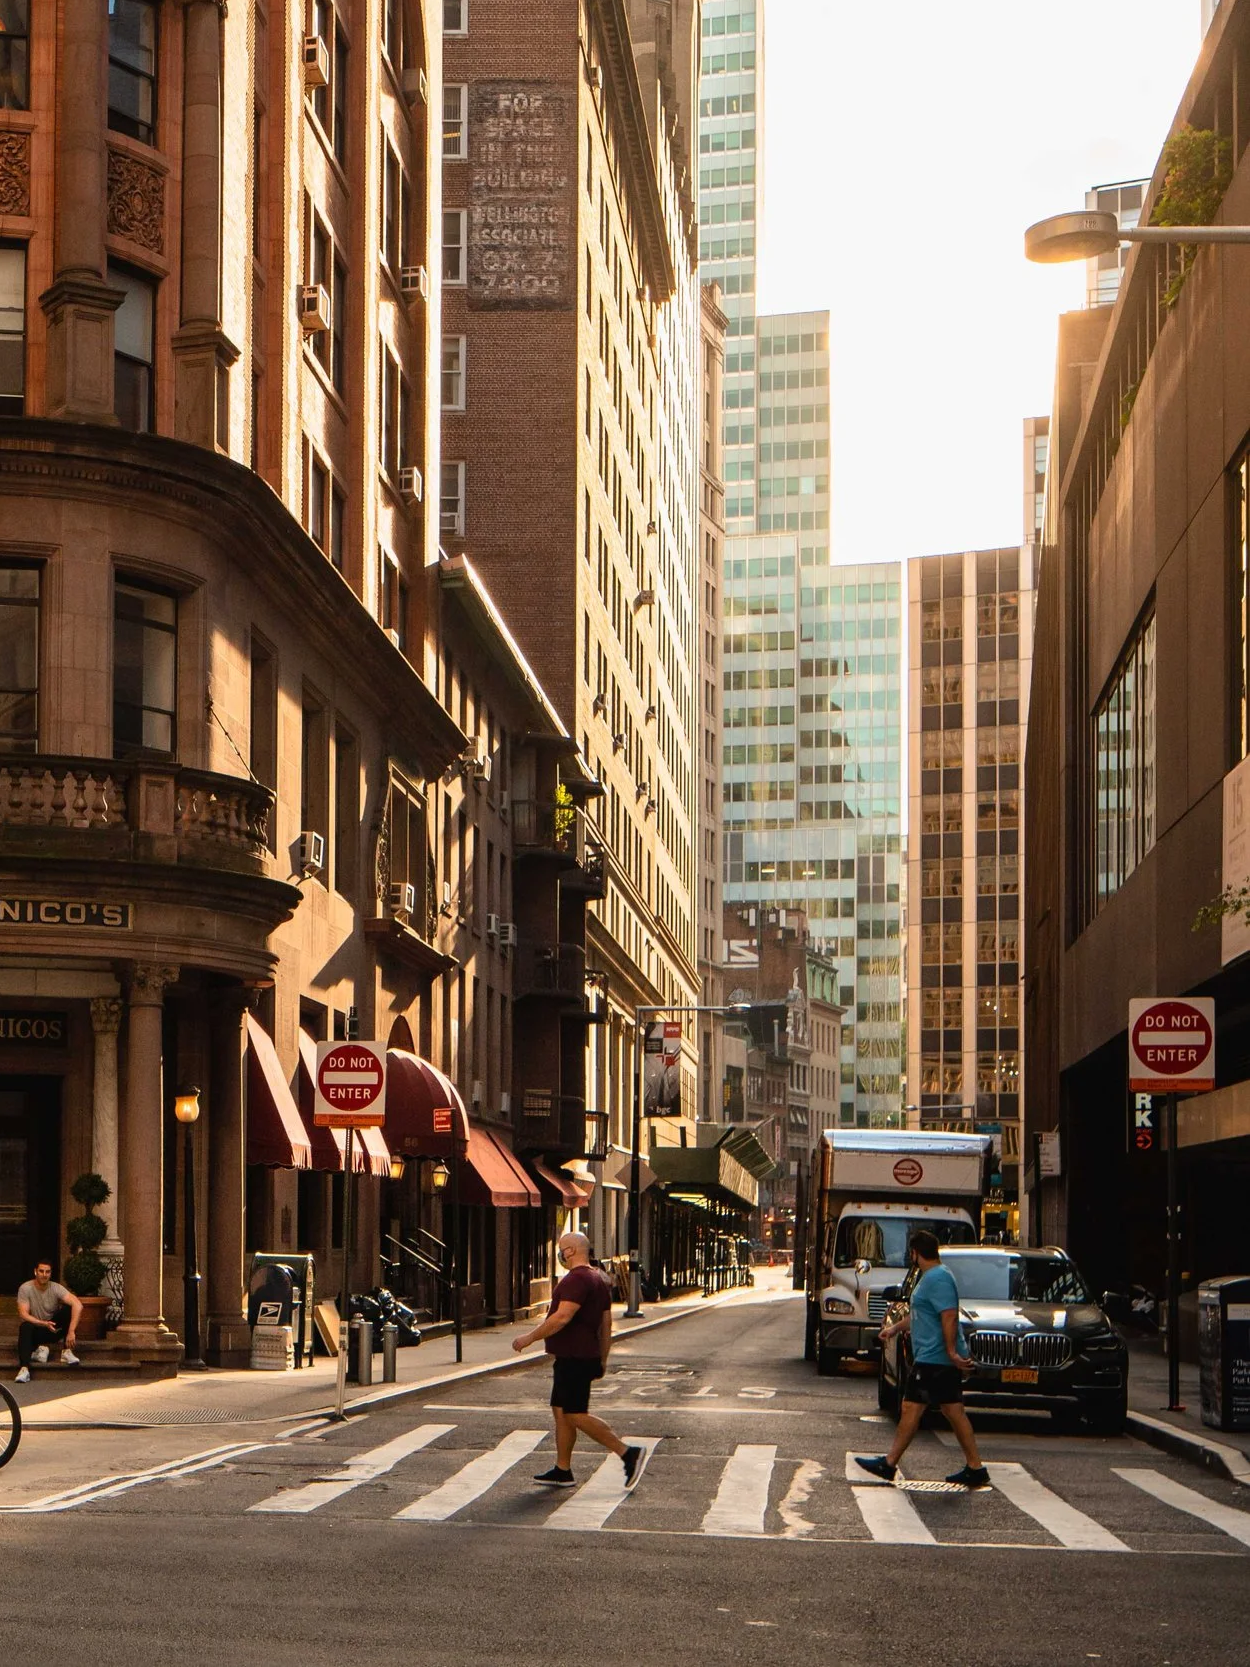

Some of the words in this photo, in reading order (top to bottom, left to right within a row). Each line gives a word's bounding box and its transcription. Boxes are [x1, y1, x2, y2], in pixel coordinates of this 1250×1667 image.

[1144, 1015, 1166, 1028] DO
[1170, 1015, 1200, 1028] NOT
[1146, 1049, 1198, 1062] ENTER
[329, 1057, 346, 1068] DO
[350, 1057, 374, 1068] NOT
[329, 1087, 371, 1099] ENTER
